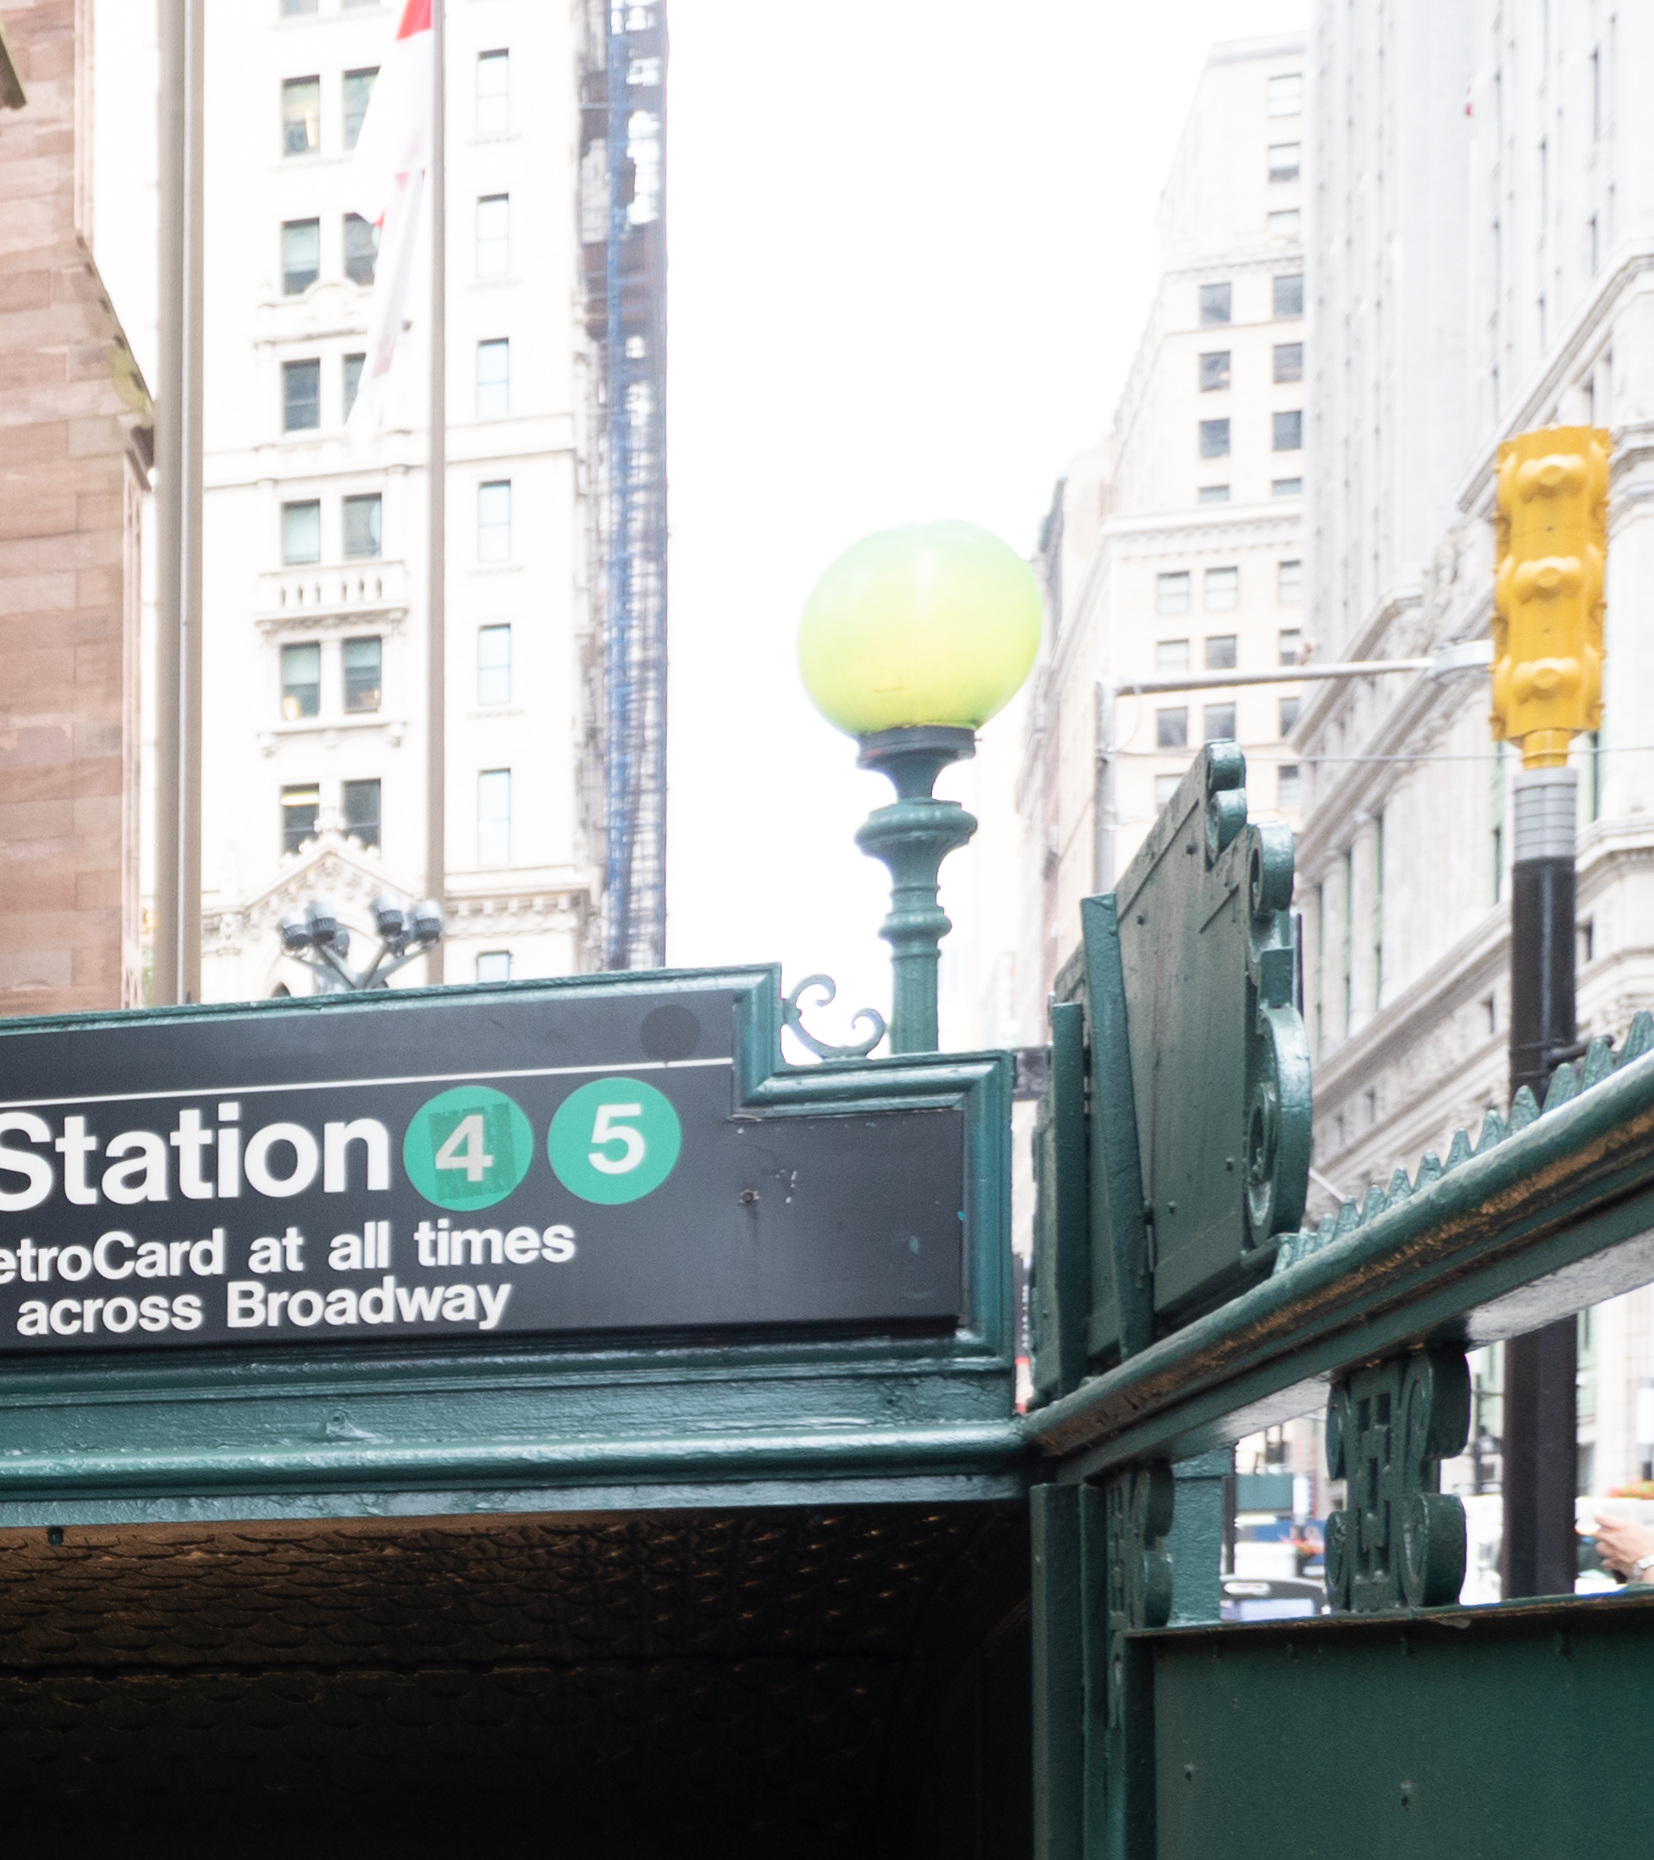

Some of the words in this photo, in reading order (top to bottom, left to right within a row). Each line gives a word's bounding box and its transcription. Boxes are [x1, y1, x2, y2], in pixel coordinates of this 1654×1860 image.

[435, 1114, 494, 1182] 4
[587, 1102, 647, 1175] 5
[249, 1227, 304, 1273] at
[329, 1221, 390, 1270] all
[414, 1220, 576, 1267] times
[17, 1294, 203, 1335] across
[228, 1276, 512, 1329] Broadway
